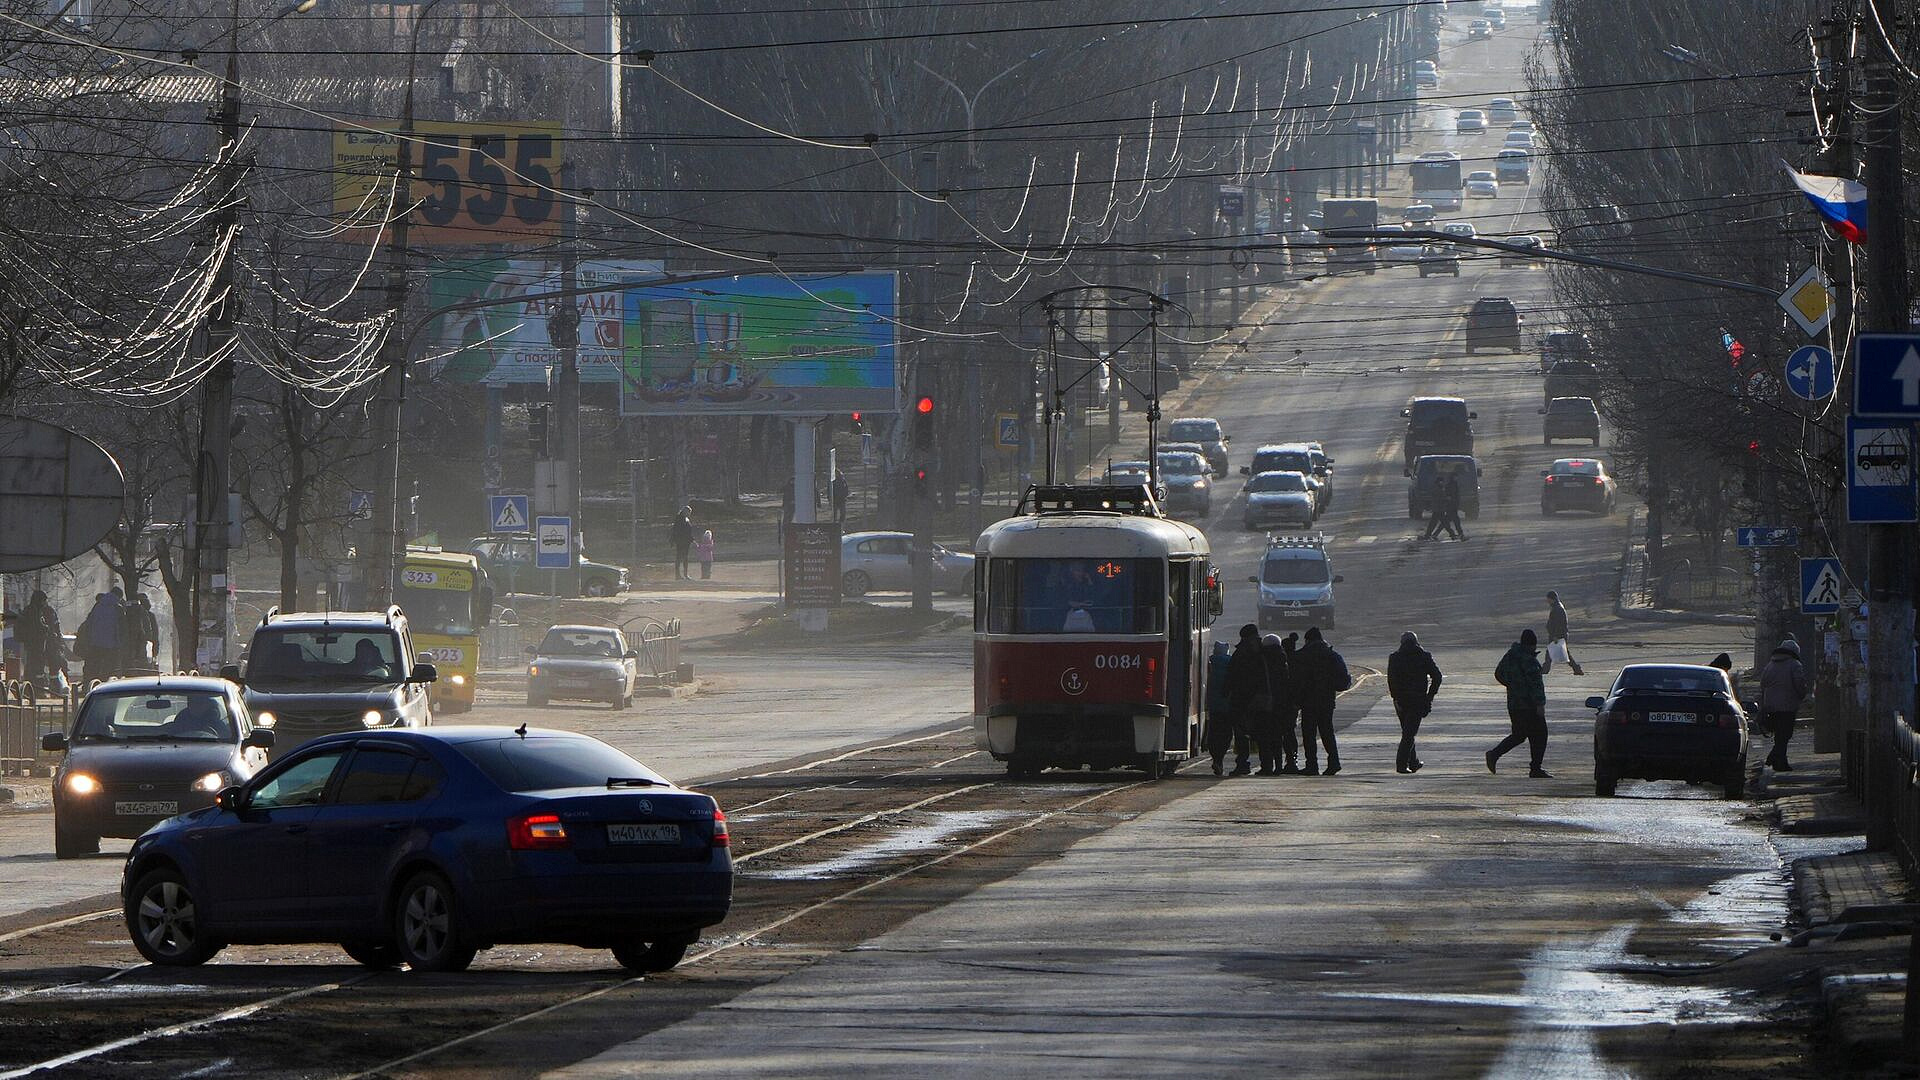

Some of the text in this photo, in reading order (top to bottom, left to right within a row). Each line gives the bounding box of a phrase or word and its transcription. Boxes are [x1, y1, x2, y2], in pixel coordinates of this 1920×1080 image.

[337, 153, 397, 162] Приглаем
[421, 133, 554, 226] 555
[515, 352, 562, 364] Спасиб
[407, 570, 434, 583] 323
[431, 649, 459, 662] 323
[1094, 654, 1142, 669] 0084
